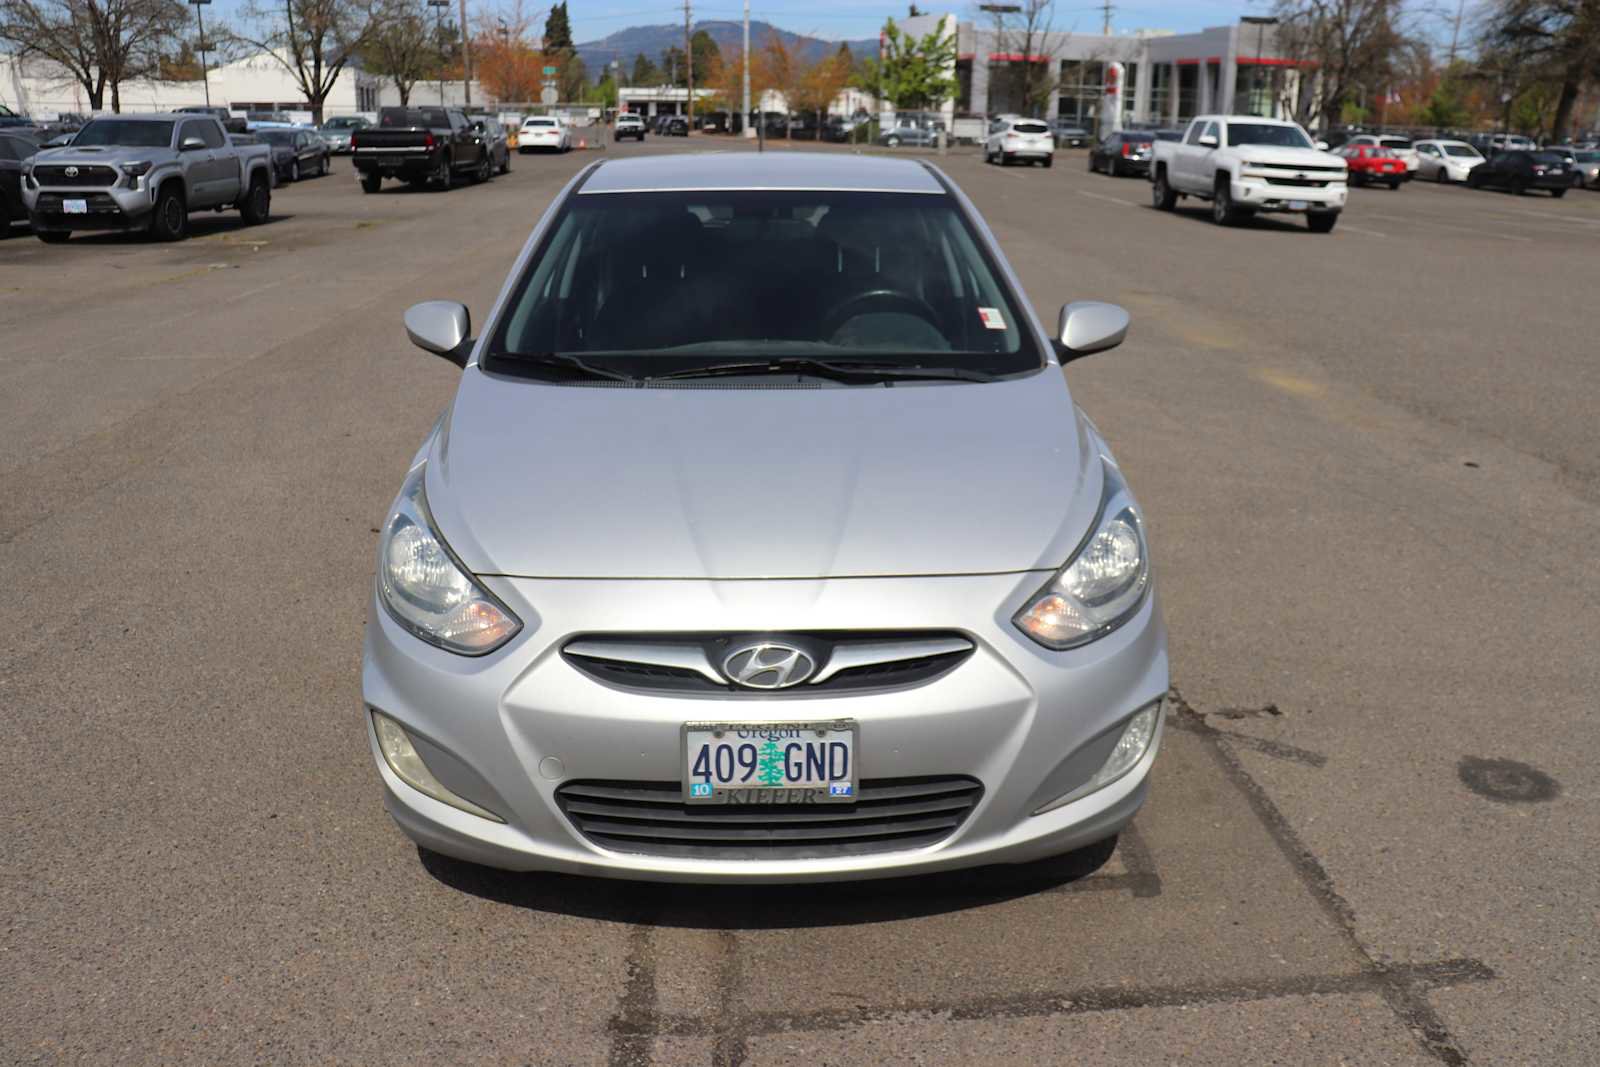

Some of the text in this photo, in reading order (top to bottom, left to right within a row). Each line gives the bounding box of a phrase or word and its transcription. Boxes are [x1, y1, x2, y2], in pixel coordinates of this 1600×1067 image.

[737, 728, 800, 742] Oregon
[692, 742, 849, 783] 409 GND
[694, 784, 709, 797] 10
